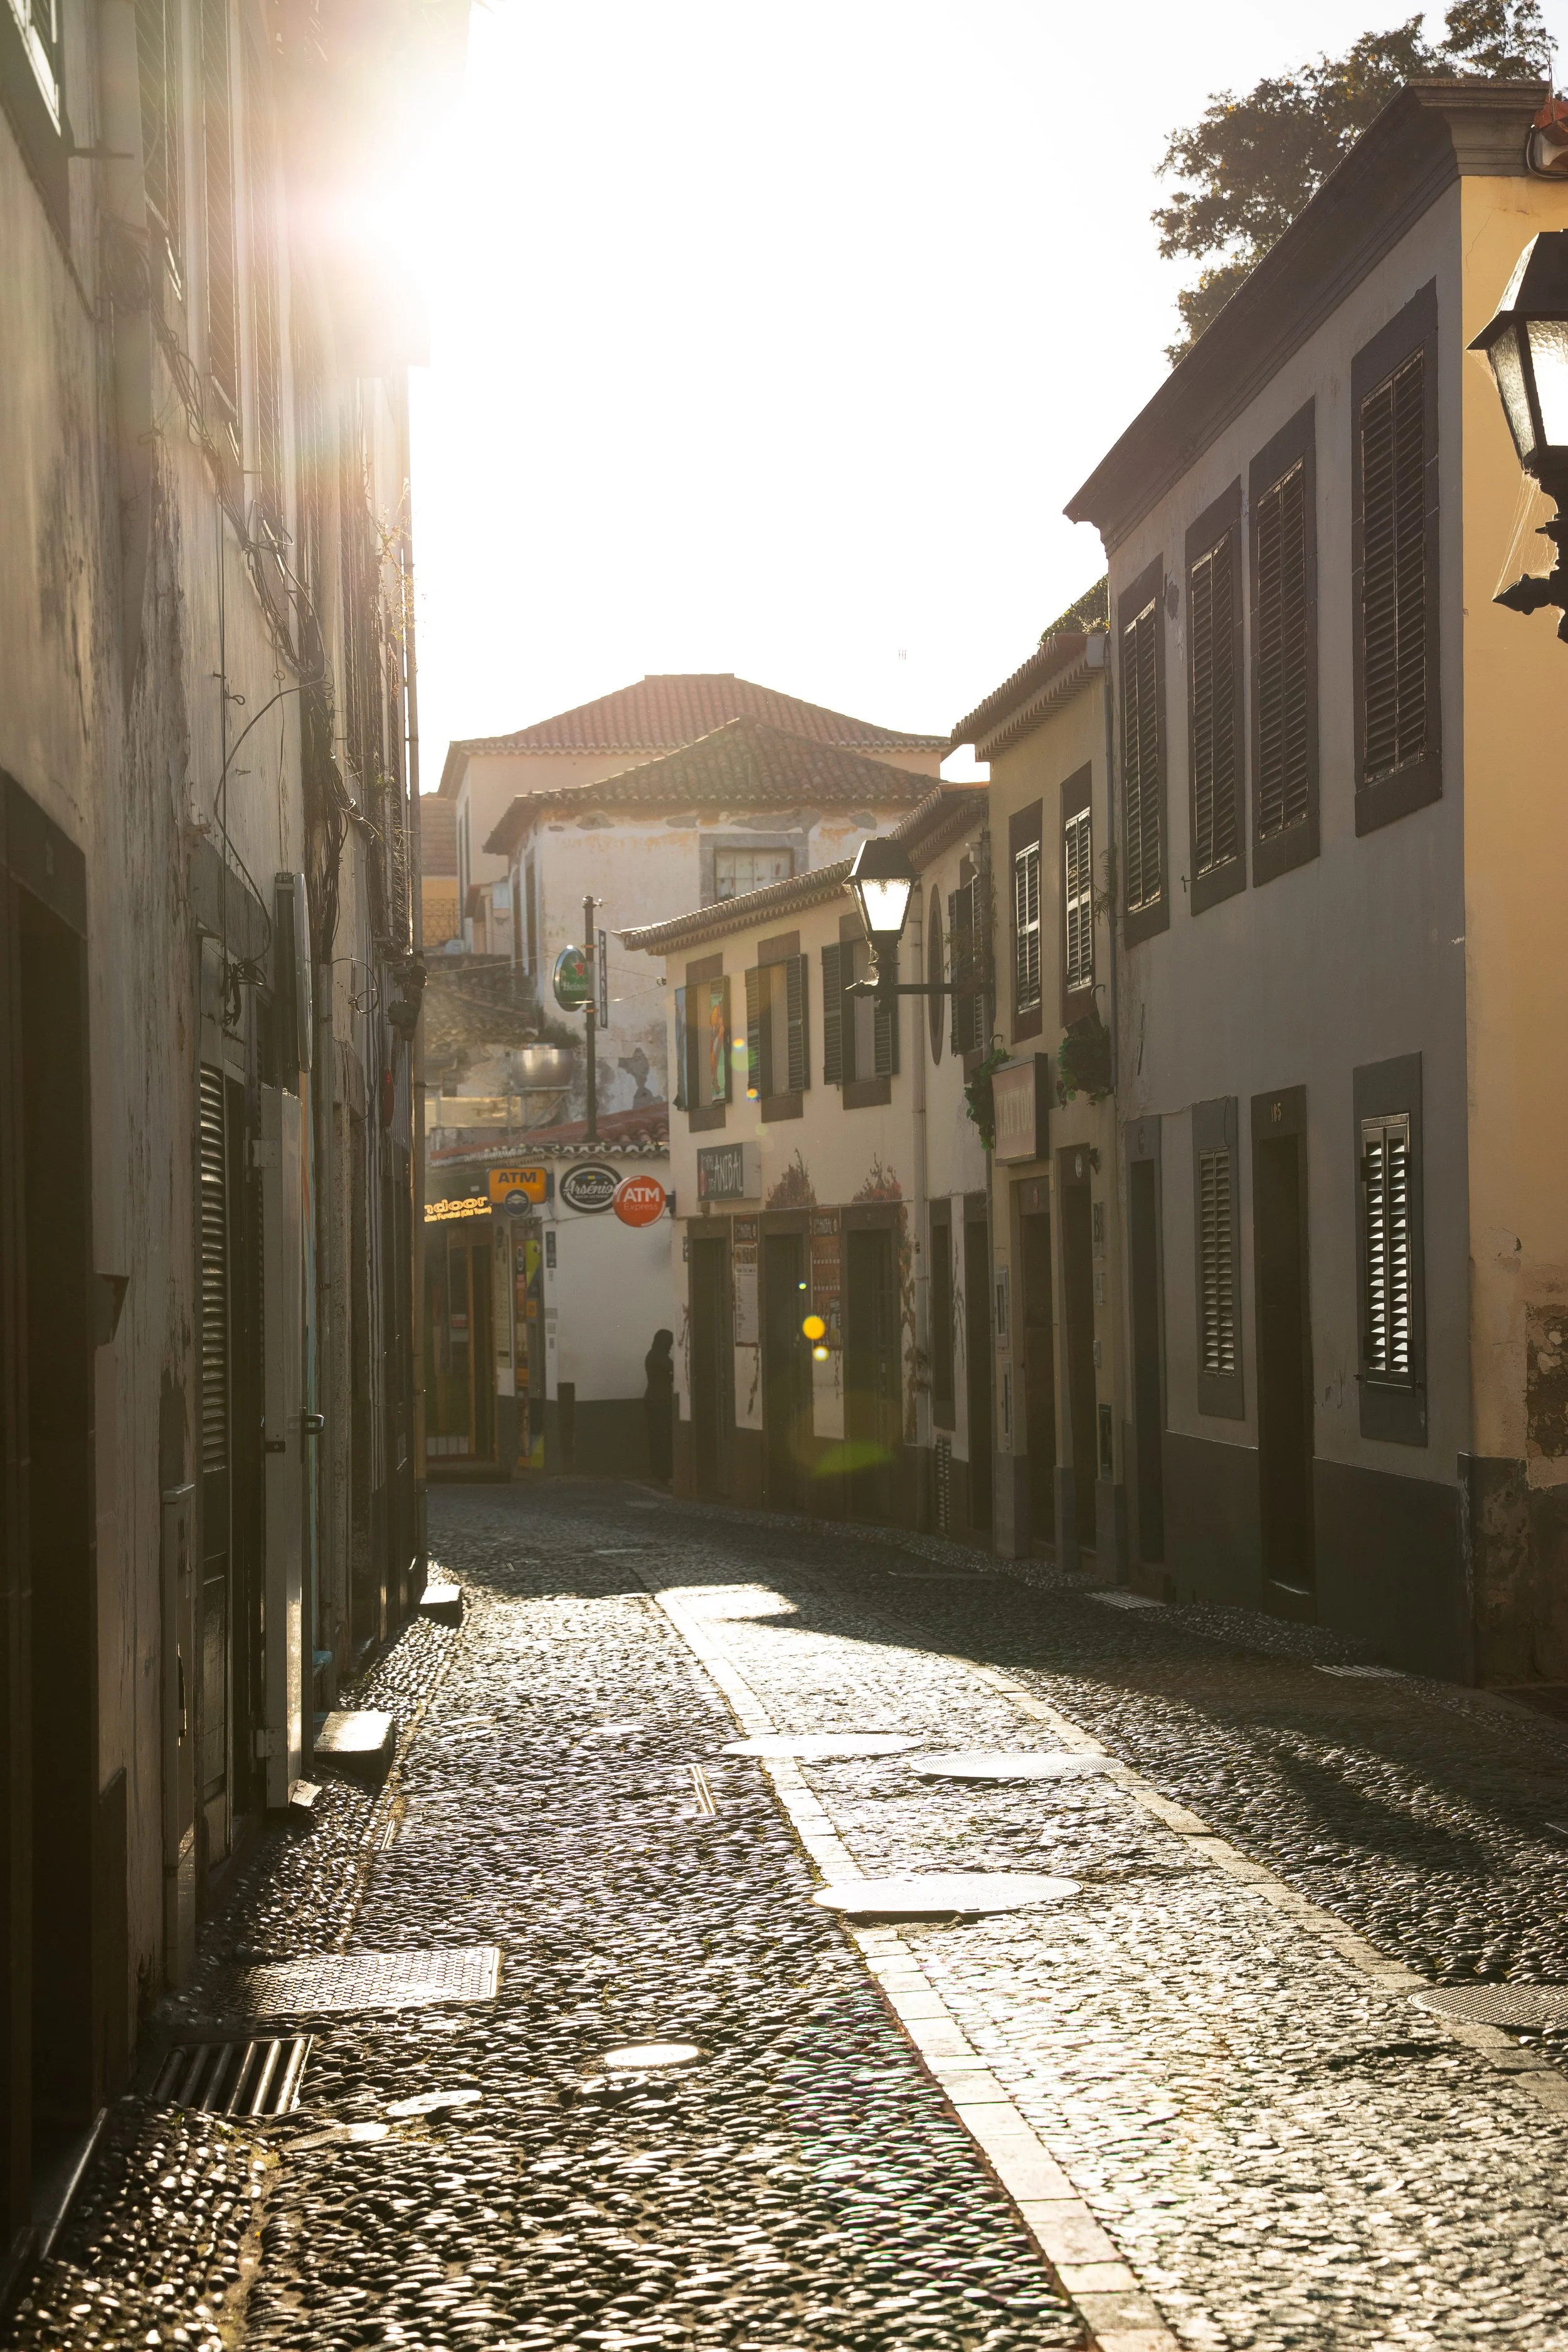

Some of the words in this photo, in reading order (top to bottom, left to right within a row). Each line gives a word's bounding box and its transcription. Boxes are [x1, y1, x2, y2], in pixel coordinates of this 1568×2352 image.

[996, 1083, 1034, 1139] TATTOO
[497, 1172, 537, 1184] ATM
[714, 1150, 743, 1192] ANIBAL
[622, 1187, 660, 1202] ATM
[437, 1210, 461, 1221] Funchal
[460, 1209, 474, 1218] (Old
[474, 1206, 492, 1216] Town)
[623, 1203, 659, 1211] Express
